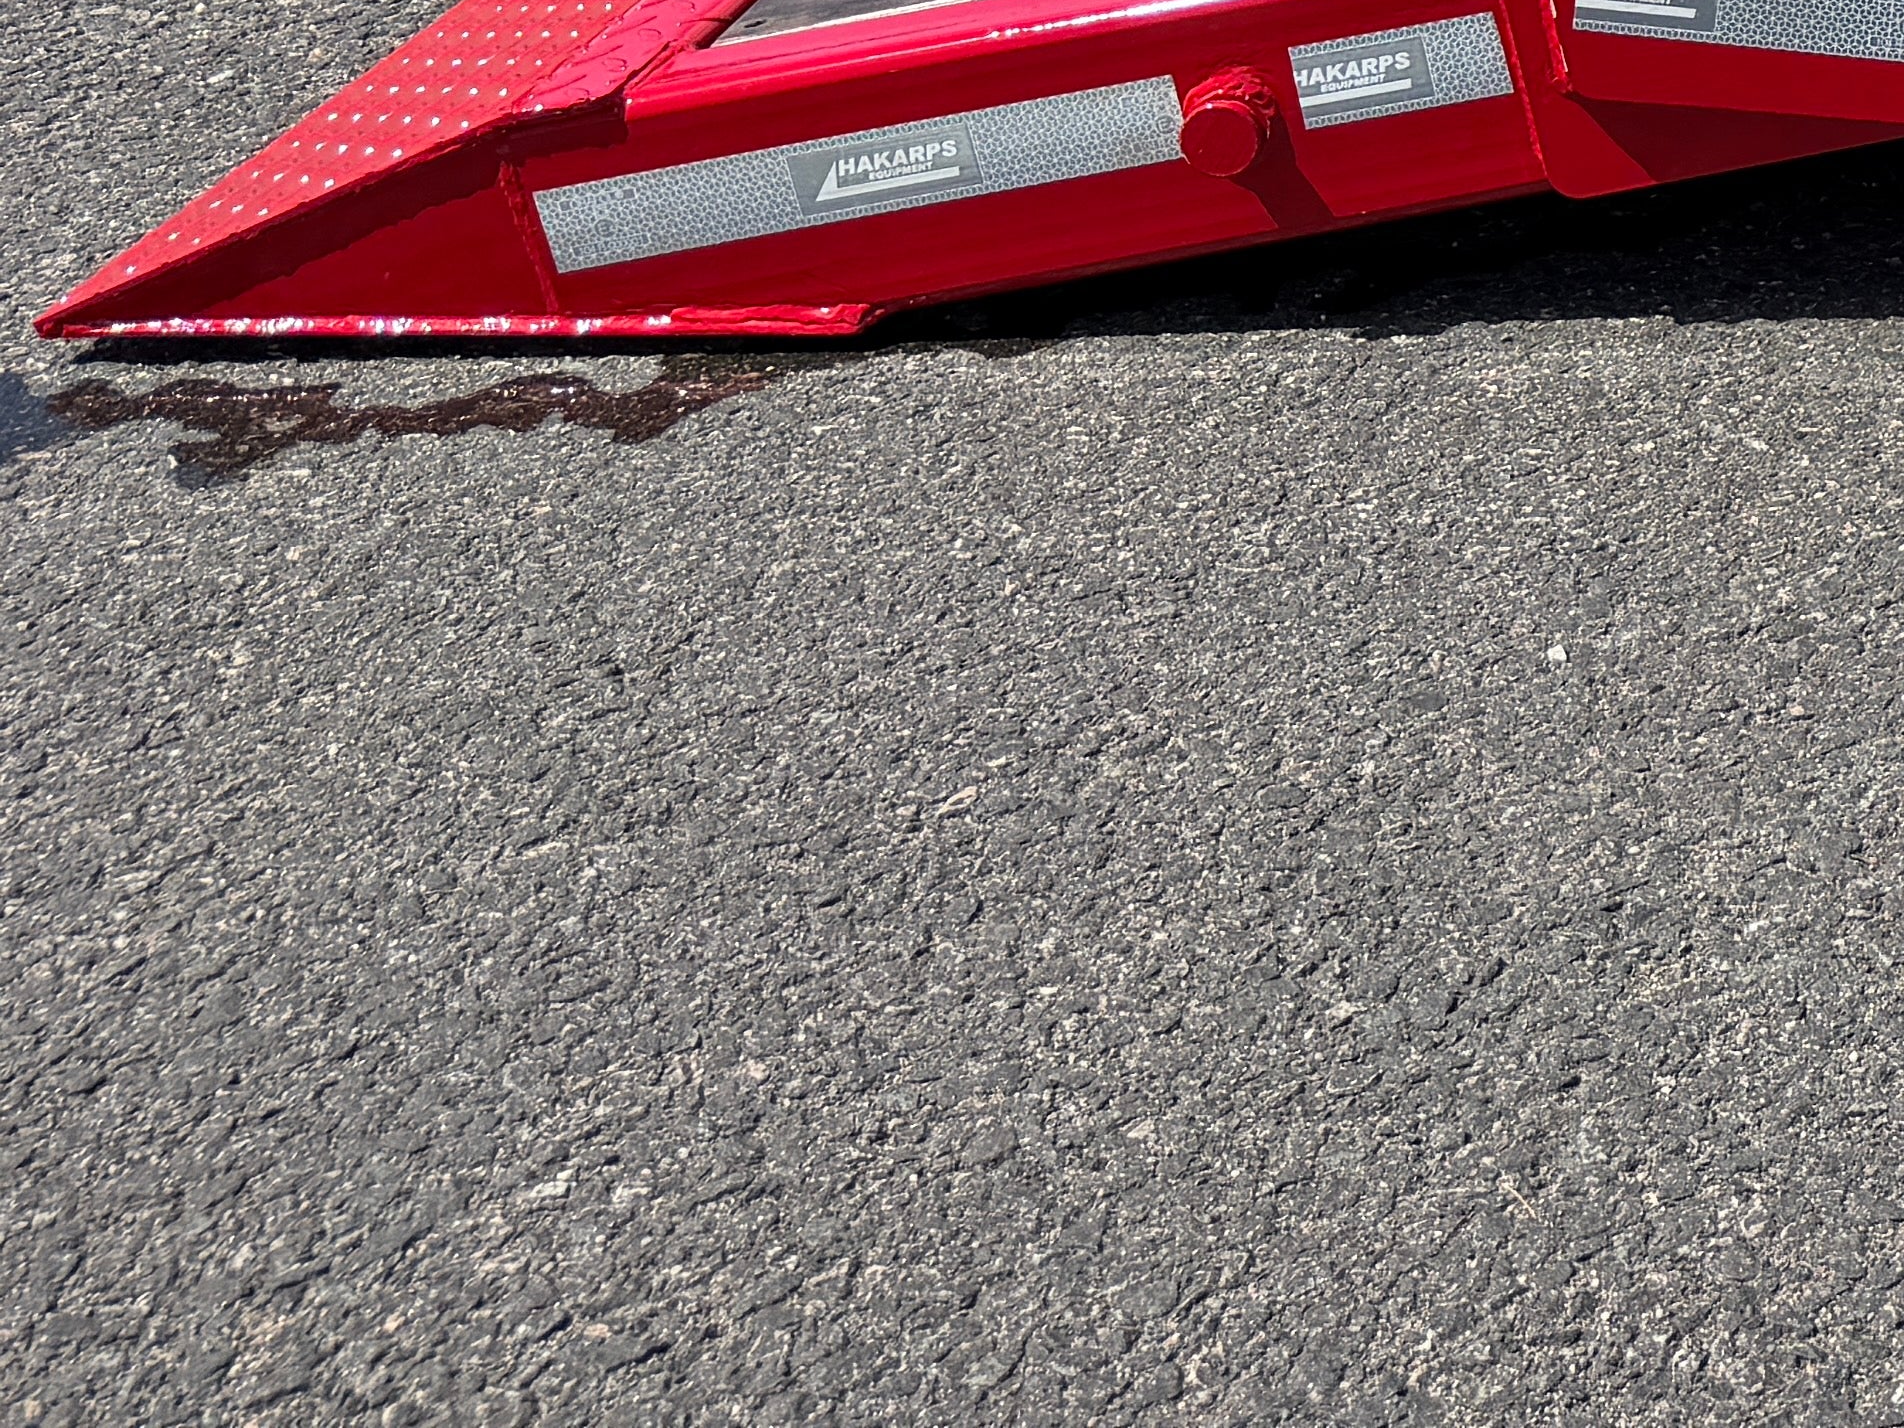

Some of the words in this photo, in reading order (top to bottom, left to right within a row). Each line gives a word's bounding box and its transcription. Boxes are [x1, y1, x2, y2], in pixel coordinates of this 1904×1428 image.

[1294, 52, 1411, 87] HAKARPS
[1320, 74, 1386, 93] EQUIPMENT
[838, 140, 958, 177] HAKARPS
[869, 162, 933, 181] EQUIPMENT
